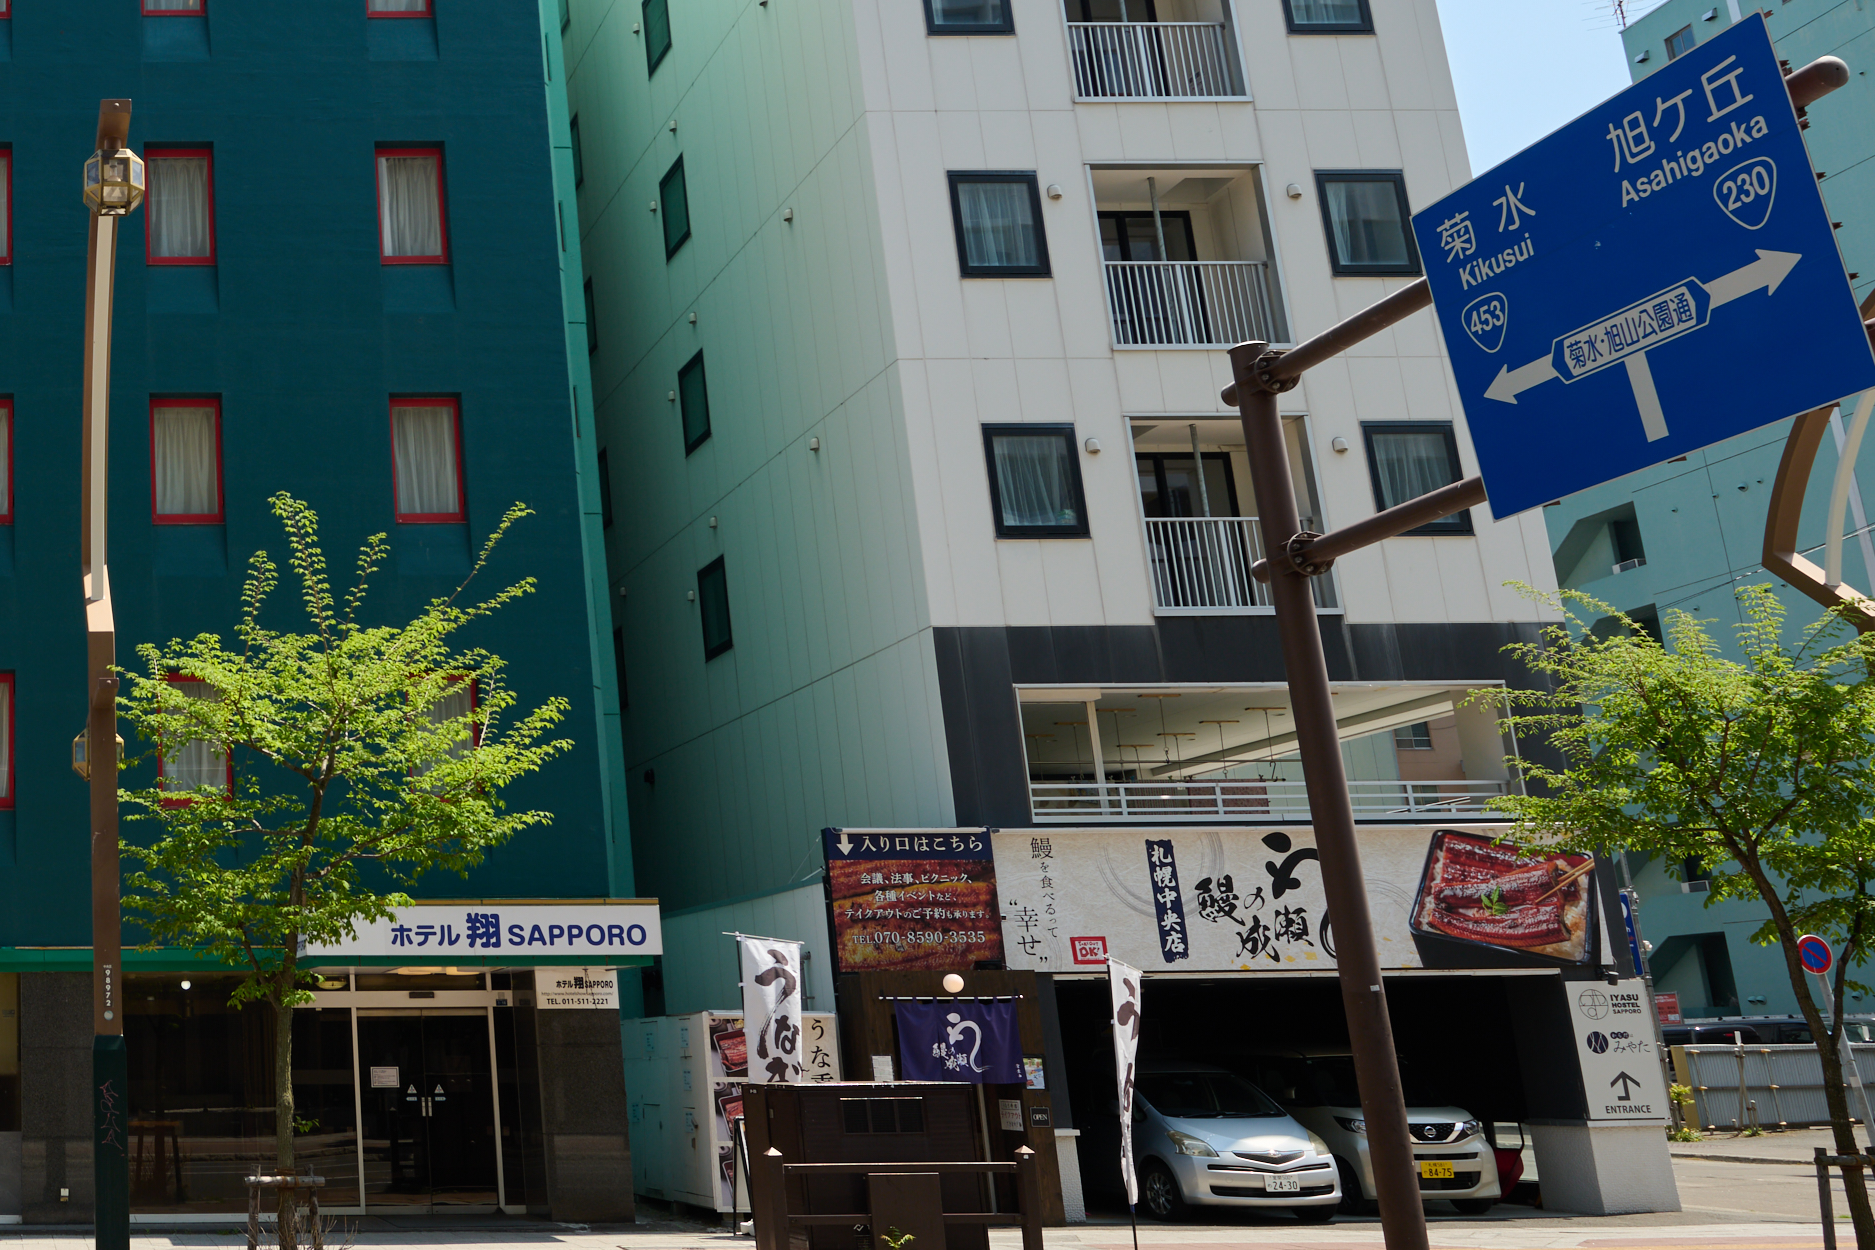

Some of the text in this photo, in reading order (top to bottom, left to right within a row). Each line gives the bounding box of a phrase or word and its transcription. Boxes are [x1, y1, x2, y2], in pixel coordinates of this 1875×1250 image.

[1621, 114, 1769, 208] Asahigaoka
[1722, 168, 1770, 211] 230
[1458, 233, 1535, 291] Kikusui
[1469, 300, 1506, 336] 453
[860, 836, 983, 852] 入り口はこちら
[860, 873, 972, 885] 会議、法事、ピクニック、
[1030, 837, 1058, 938] 鰻を食べるって
[875, 890, 957, 902] 各種イベントなど、
[1151, 845, 1186, 954] 札幌中央店
[844, 908, 990, 920] テイクアウトのご予約も承ります。
[508, 924, 647, 947] SAPPORO
[1079, 947, 1100, 958] OK!
[585, 980, 613, 989] SAPPORO
[1613, 1040, 1651, 1053] みやた
[1605, 1105, 1652, 1114] ENTRANCE
[1032, 1113, 1048, 1121] OPEN
[1428, 1167, 1452, 1177] 84-75
[1272, 1180, 1298, 1190] 24-30
